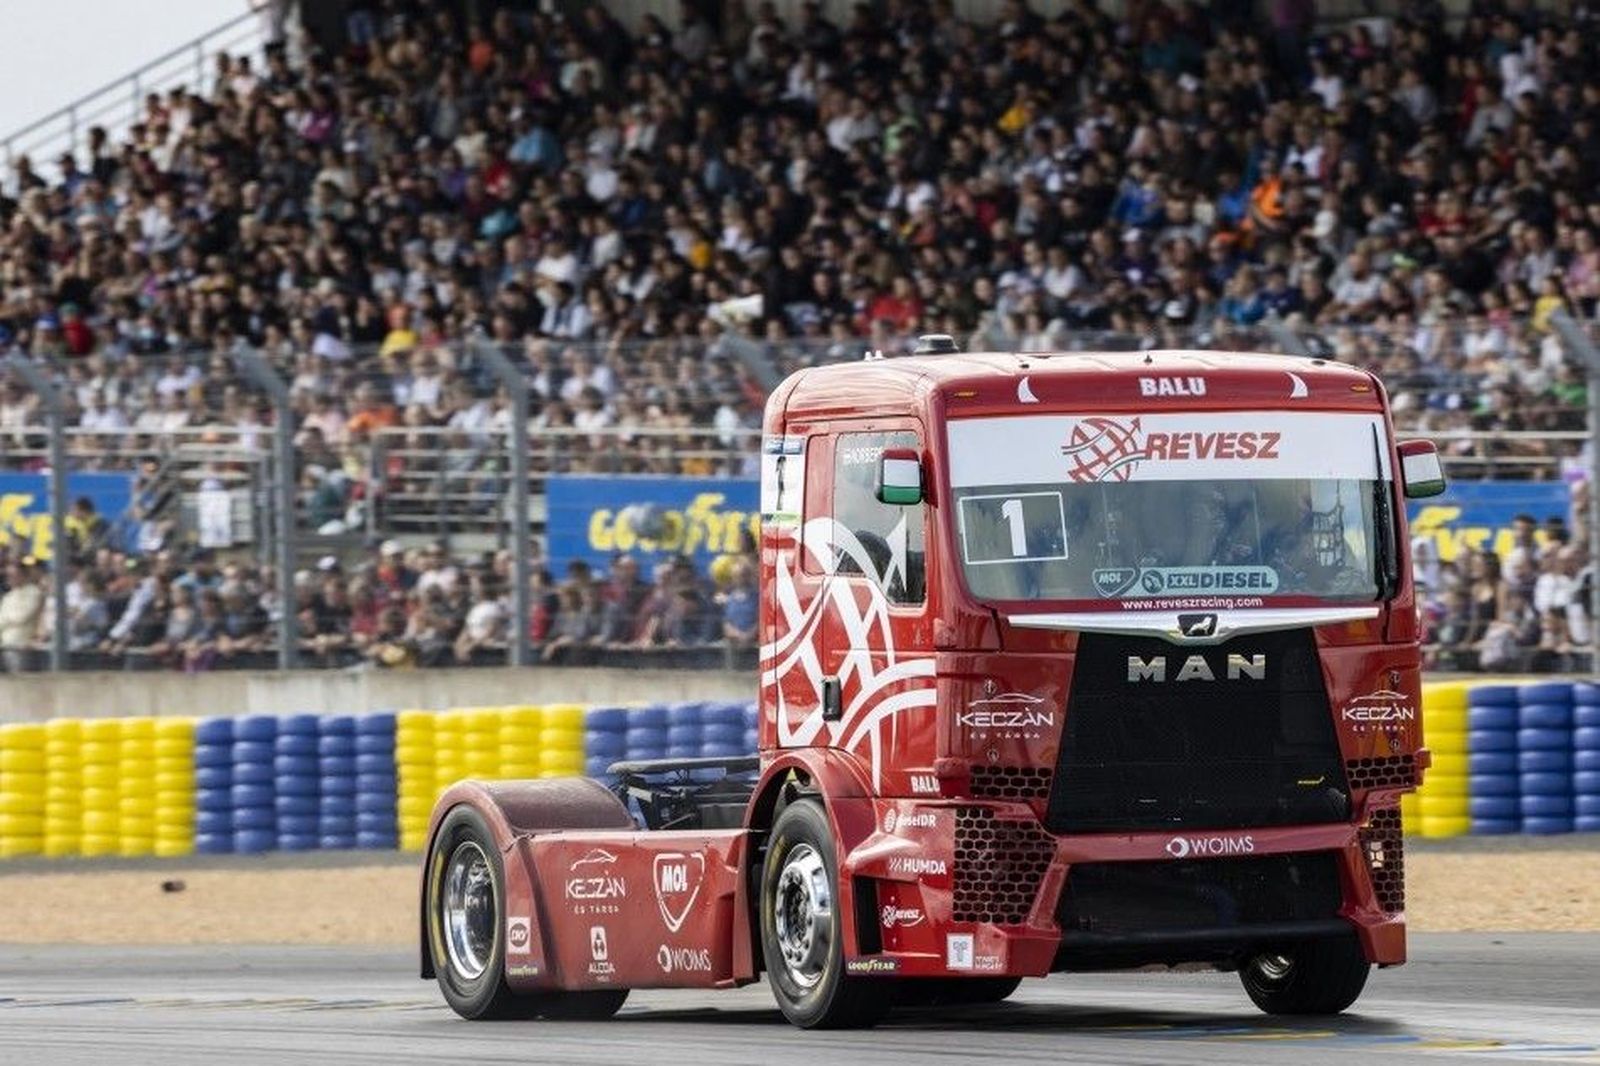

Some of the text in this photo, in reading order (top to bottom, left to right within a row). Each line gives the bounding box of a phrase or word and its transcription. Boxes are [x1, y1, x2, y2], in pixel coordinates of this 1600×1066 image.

[1139, 377, 1206, 397] BALU
[1146, 432, 1281, 461] REVESZ
[1000, 500, 1027, 556] 1
[1168, 572, 1272, 589] XXL DIESEL
[1121, 596, 1263, 611] www.reveszracing.com
[1127, 654, 1266, 683] MAN
[911, 776, 940, 793] BALU
[1191, 835, 1254, 855] WOIMS
[903, 858, 947, 875] HUMDA
[671, 948, 712, 971] WOIMS
